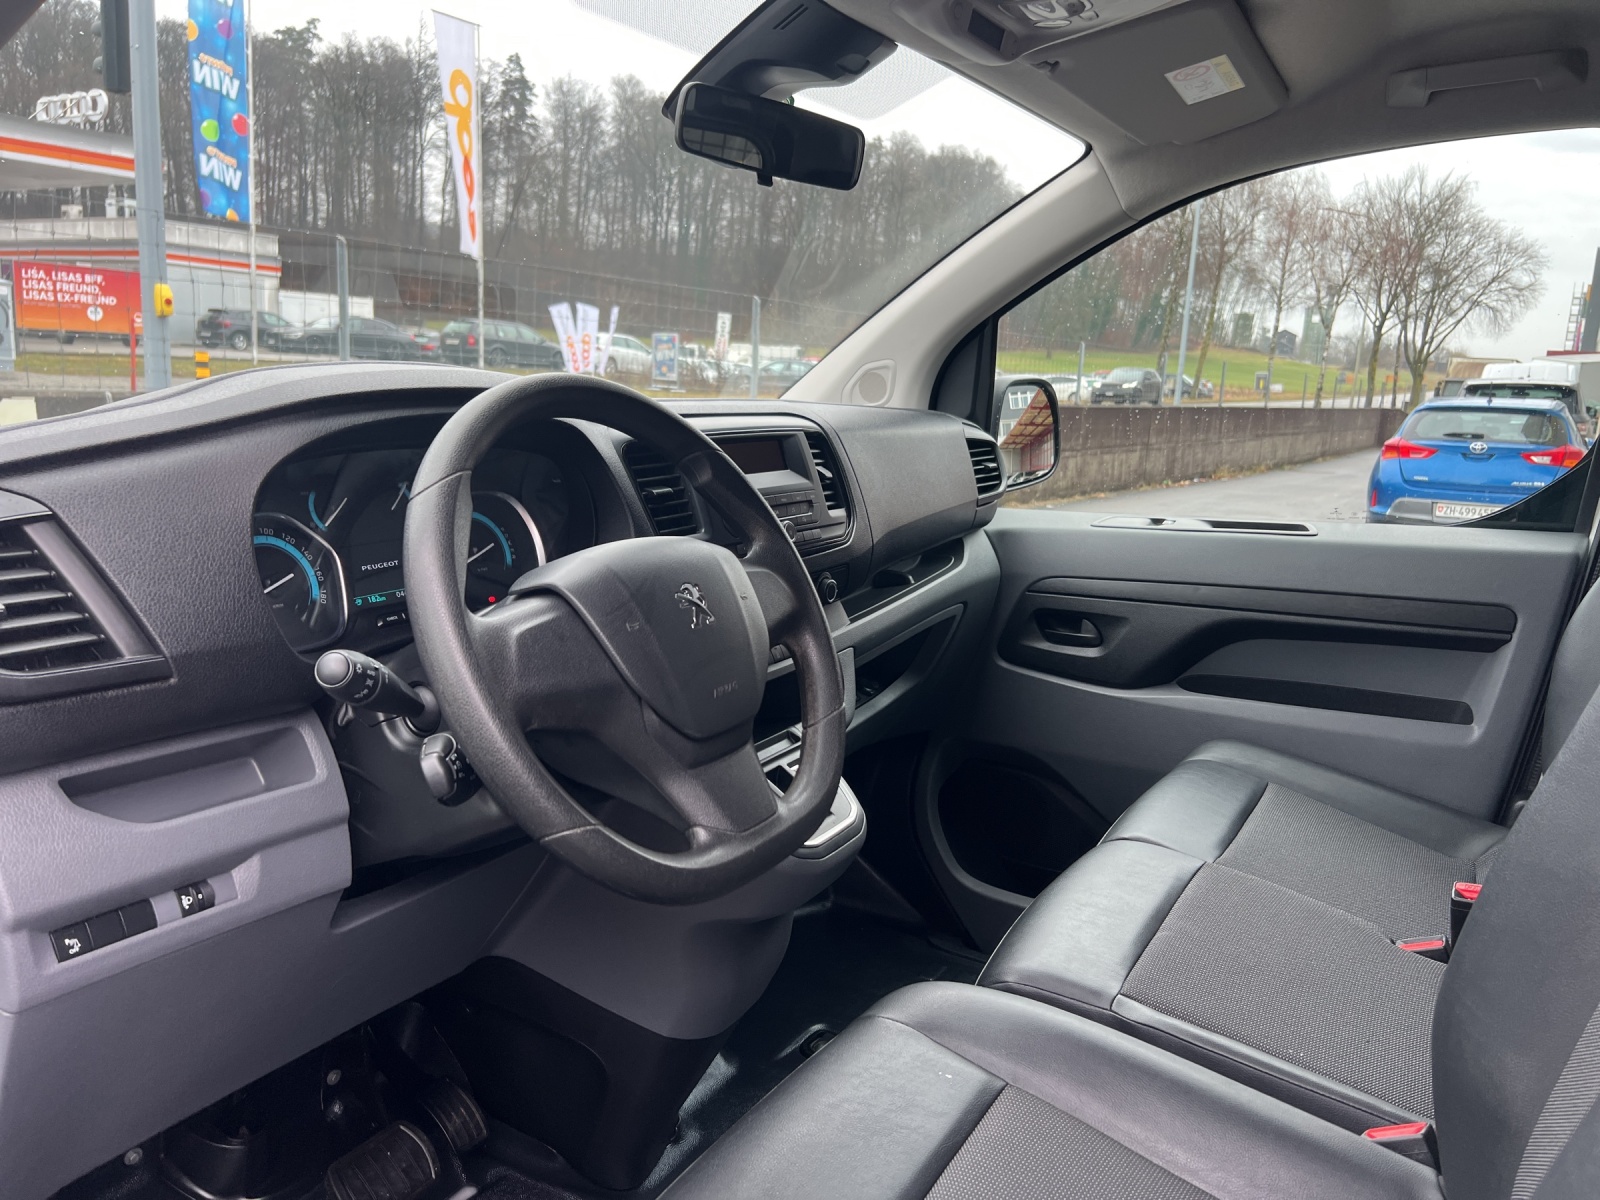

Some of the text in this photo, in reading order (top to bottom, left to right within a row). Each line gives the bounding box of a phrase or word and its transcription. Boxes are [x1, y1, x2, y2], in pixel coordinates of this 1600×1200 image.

[21, 267, 49, 281] LISA,
[52, 270, 82, 283] LISAS
[22, 279, 102, 295] LISAS FREUND,
[23, 289, 54, 302] LISAS
[57, 292, 117, 307] EX-FREUND
[259, 527, 274, 536] 100
[281, 532, 296, 545] 120
[300, 546, 313, 561] 140
[361, 560, 399, 571] PEUGEOT
[314, 566, 325, 582] 160
